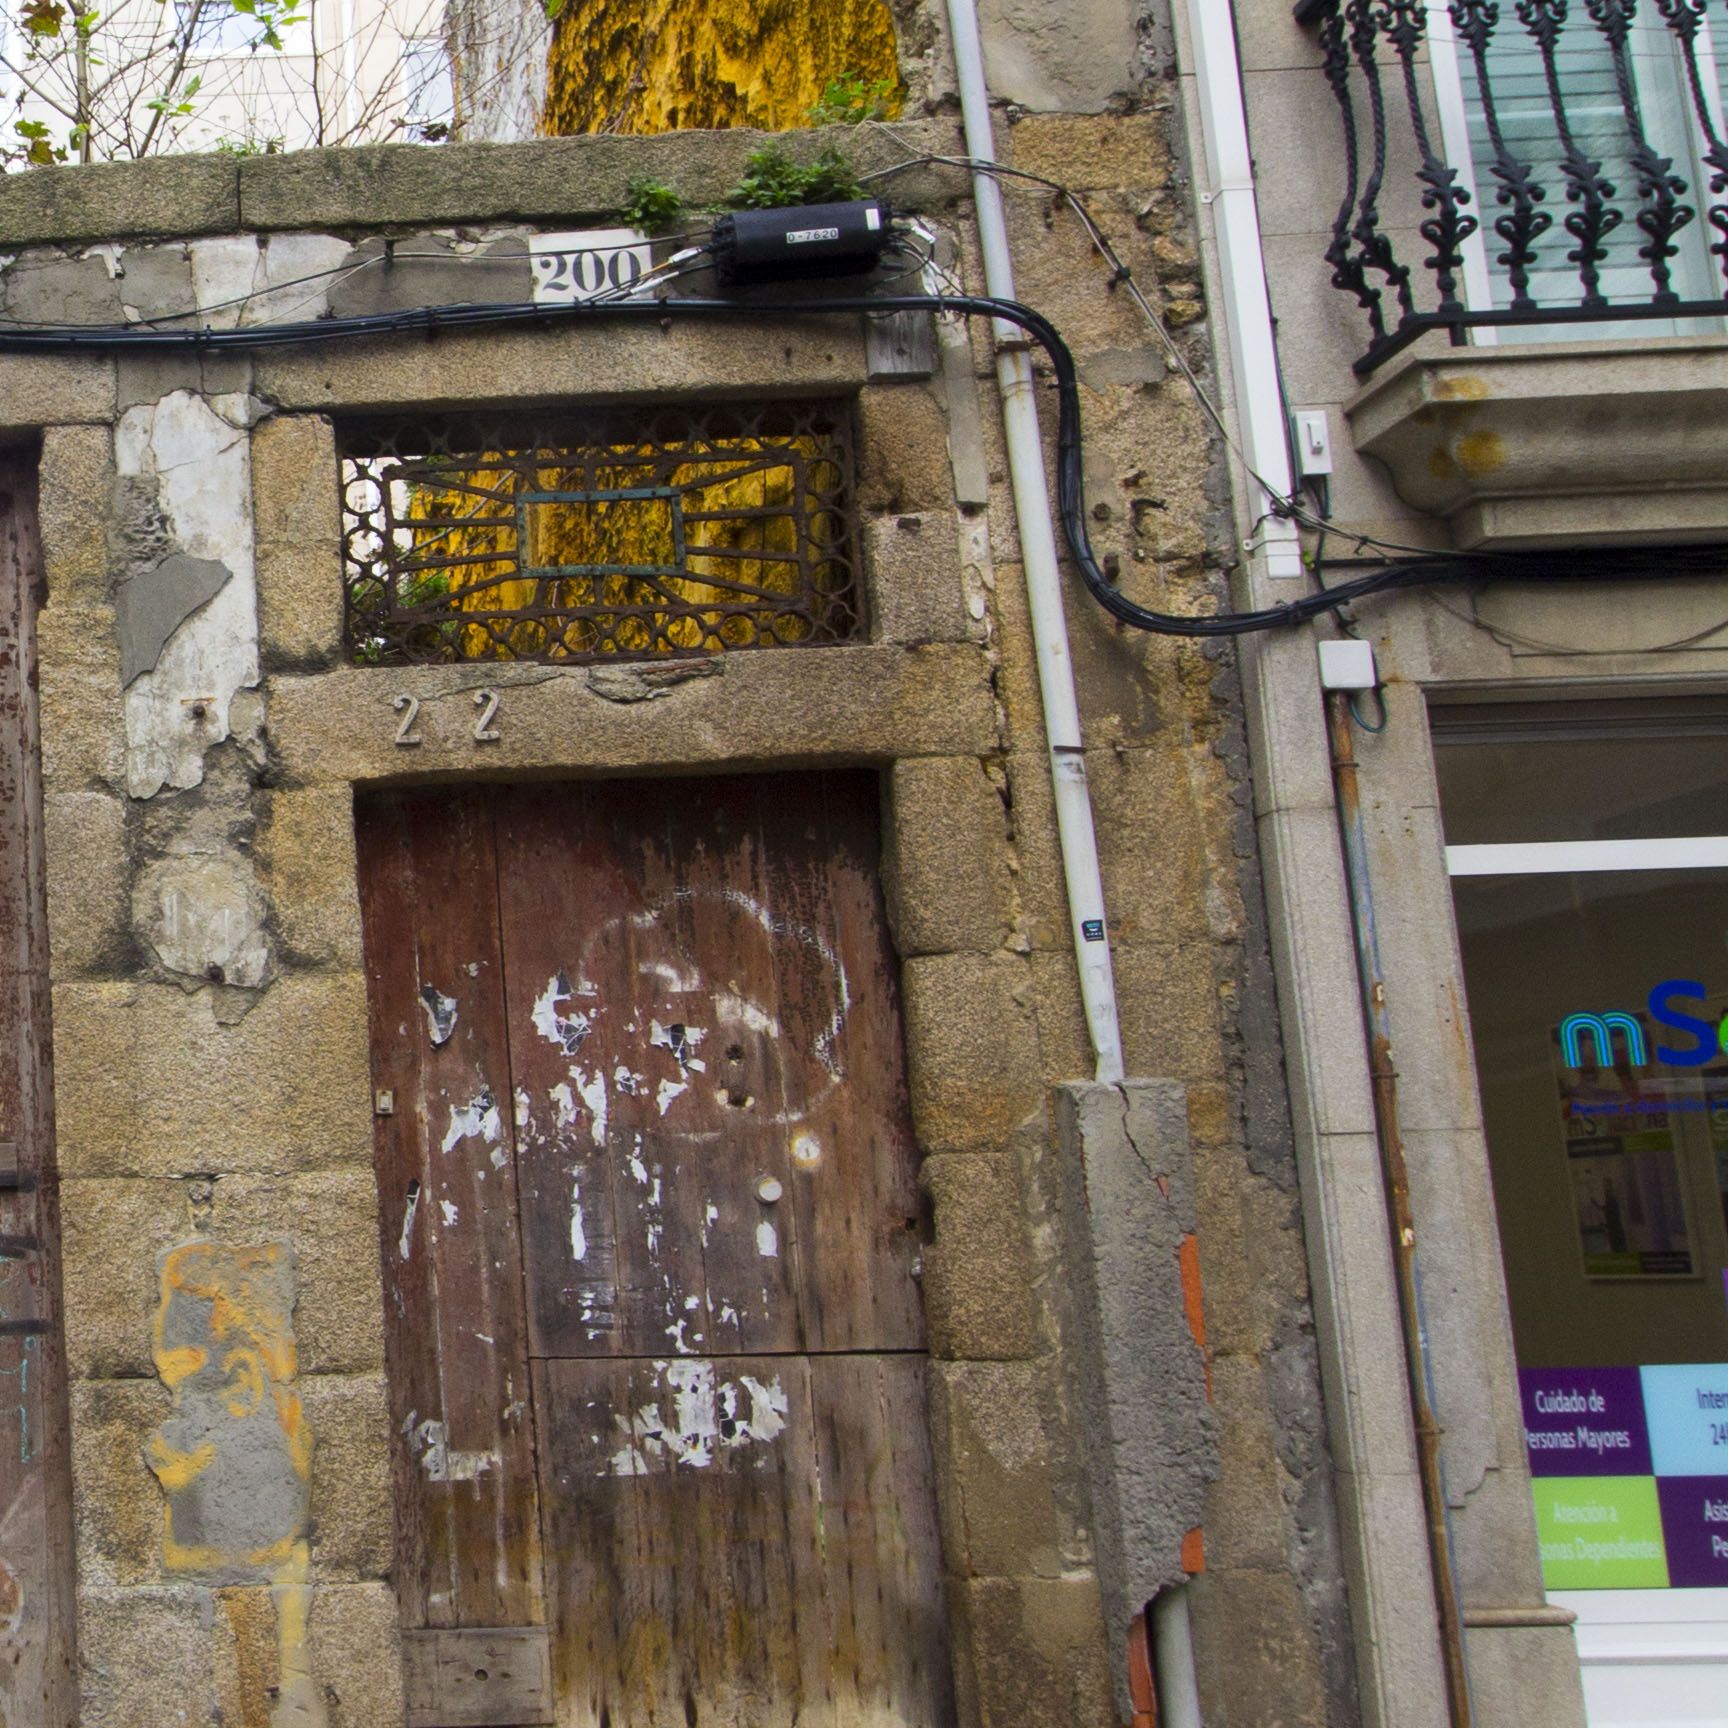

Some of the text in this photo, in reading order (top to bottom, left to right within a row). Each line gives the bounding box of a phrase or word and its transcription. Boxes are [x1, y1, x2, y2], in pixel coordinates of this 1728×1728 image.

[540, 248, 642, 293] 200
[1560, 978, 1728, 1068] mS
[1535, 1388, 1605, 1413] Cuidado de
[1576, 1425, 1632, 1456] Mayores
[1711, 1422, 1728, 1447] 24
